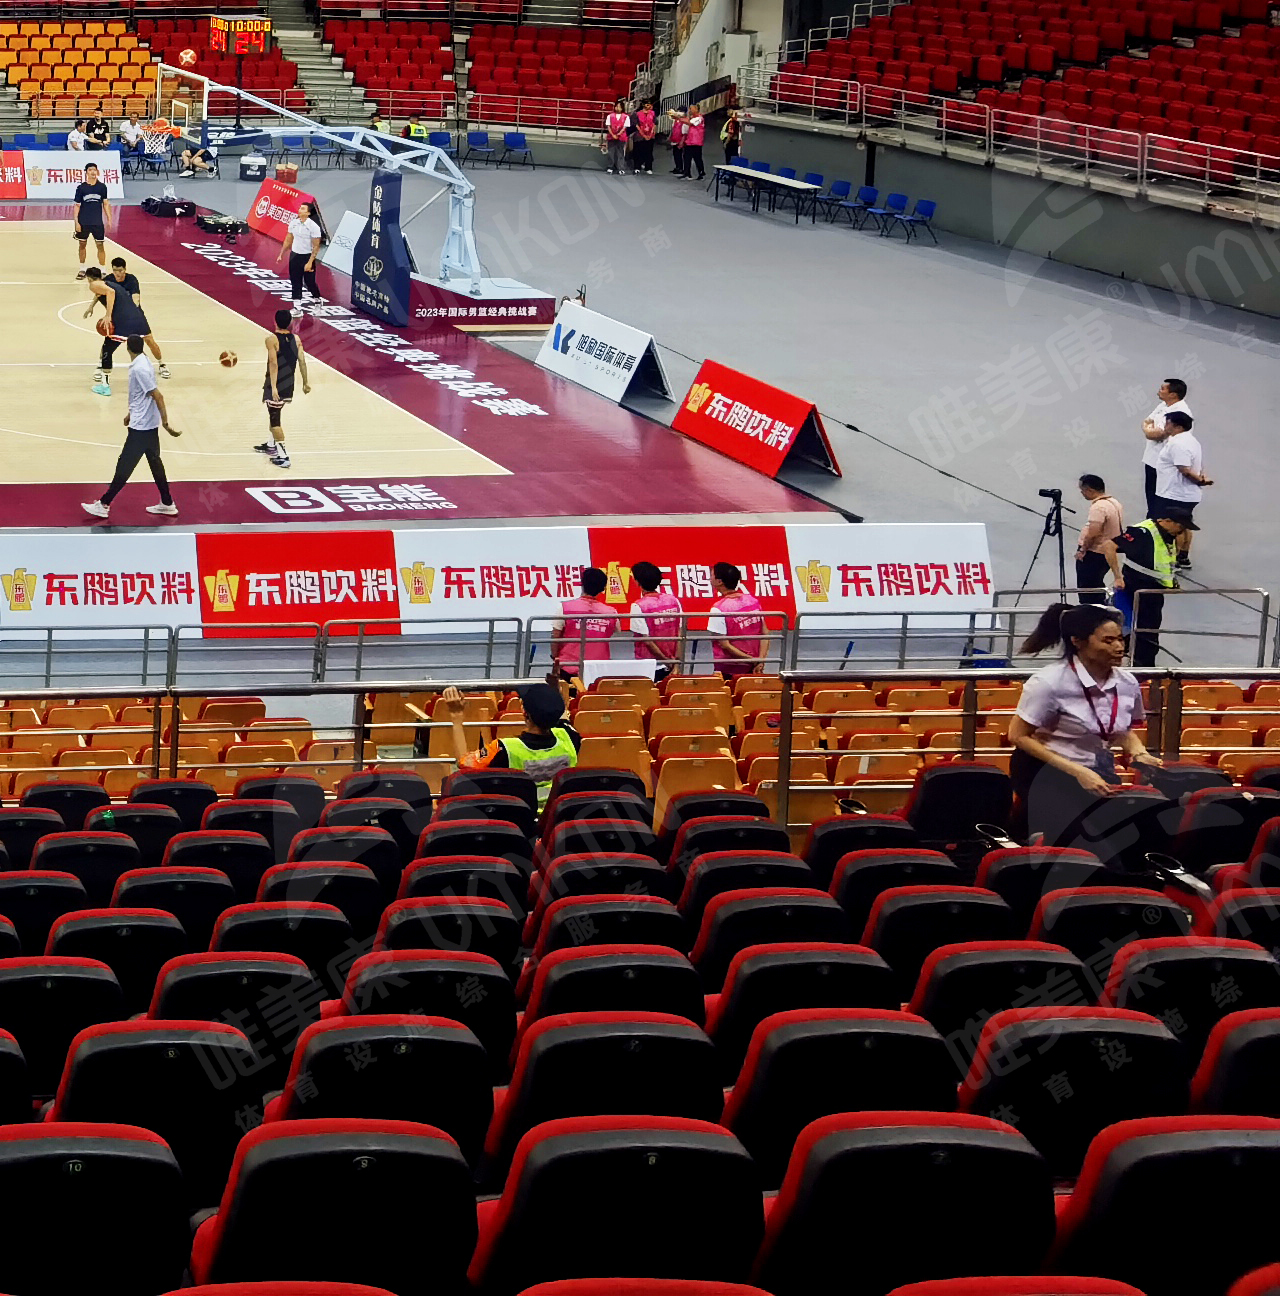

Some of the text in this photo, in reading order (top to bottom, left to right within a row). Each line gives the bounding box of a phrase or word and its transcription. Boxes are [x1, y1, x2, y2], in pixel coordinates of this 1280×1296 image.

[234, 32, 266, 54] 24
[370, 184, 383, 250] 金陵体育
[416, 306, 538, 318] 2023年国际男篮经典挑战赛
[575, 330, 637, 375] 旭励国际体育
[706, 392, 793, 451] 东鹏饮料
[324, 483, 446, 504] 宝能
[348, 501, 458, 512] BAONENG
[44, 571, 195, 607] 东鹏饮料
[247, 568, 398, 606] 东鹏饮料
[441, 564, 587, 599] 东鹏饮料
[839, 562, 991, 596] 东鹏饮料
